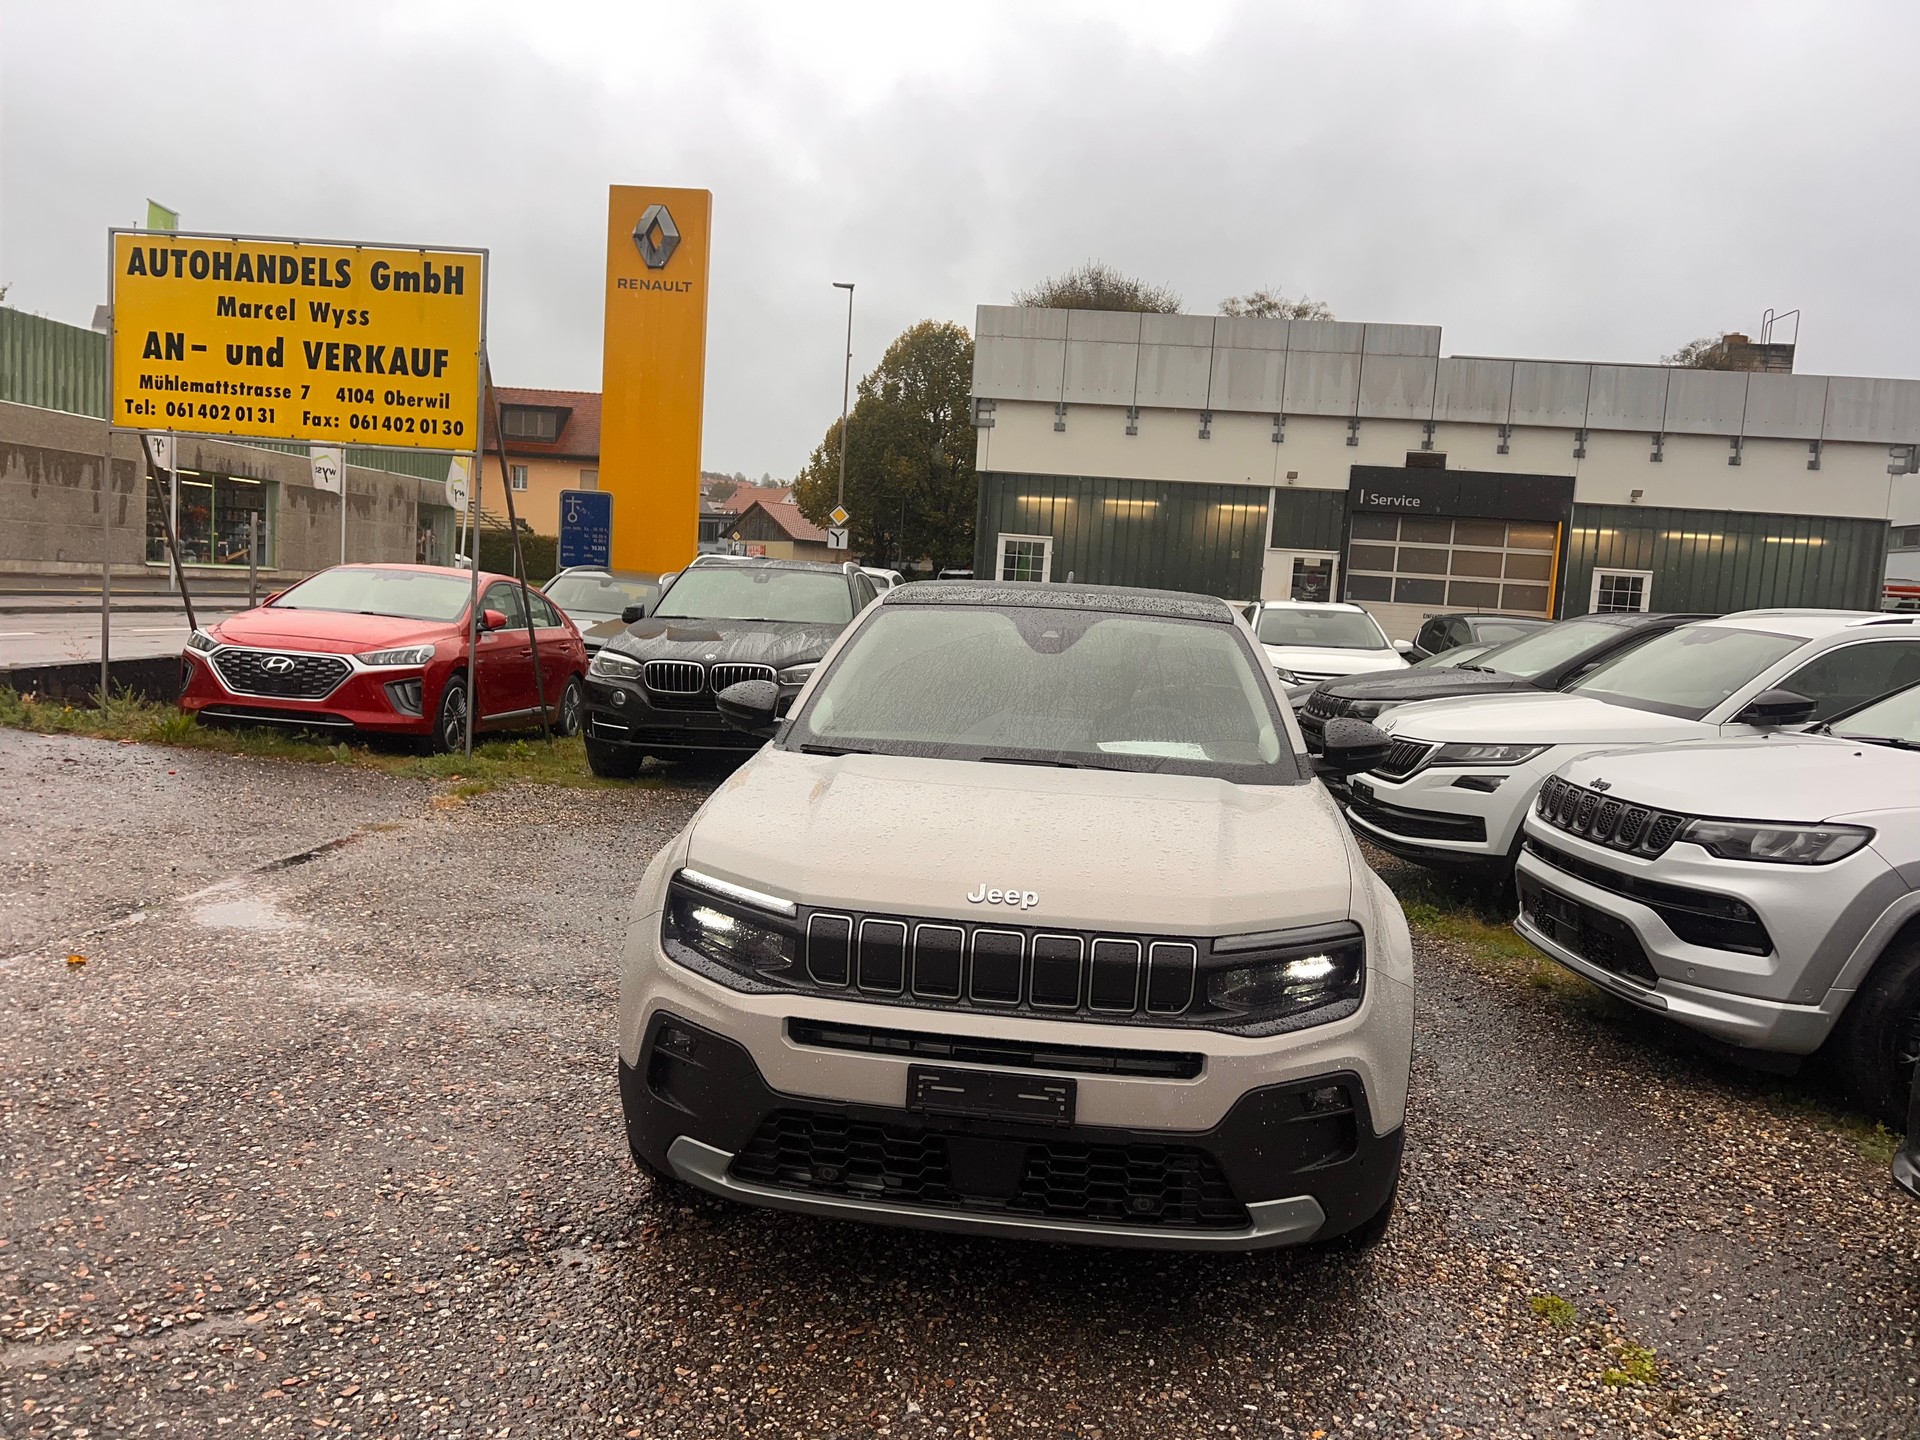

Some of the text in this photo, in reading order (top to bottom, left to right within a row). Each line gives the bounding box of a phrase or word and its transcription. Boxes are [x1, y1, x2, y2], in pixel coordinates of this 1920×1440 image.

[127, 247, 464, 295] AUTOHANDELS GmbH
[617, 278, 692, 292] RENAULT
[217, 296, 370, 328] Marcel Wyss
[226, 336, 284, 368] und
[303, 340, 449, 378] VERKAUF
[139, 374, 450, 409] Mühlemattstrasse 7 4104 Oberwil
[125, 399, 156, 416] Tel:
[303, 411, 340, 428] Fax:
[1370, 493, 1421, 507] Service
[1590, 777, 1612, 792] Jeep
[967, 883, 1039, 911] Jeep
